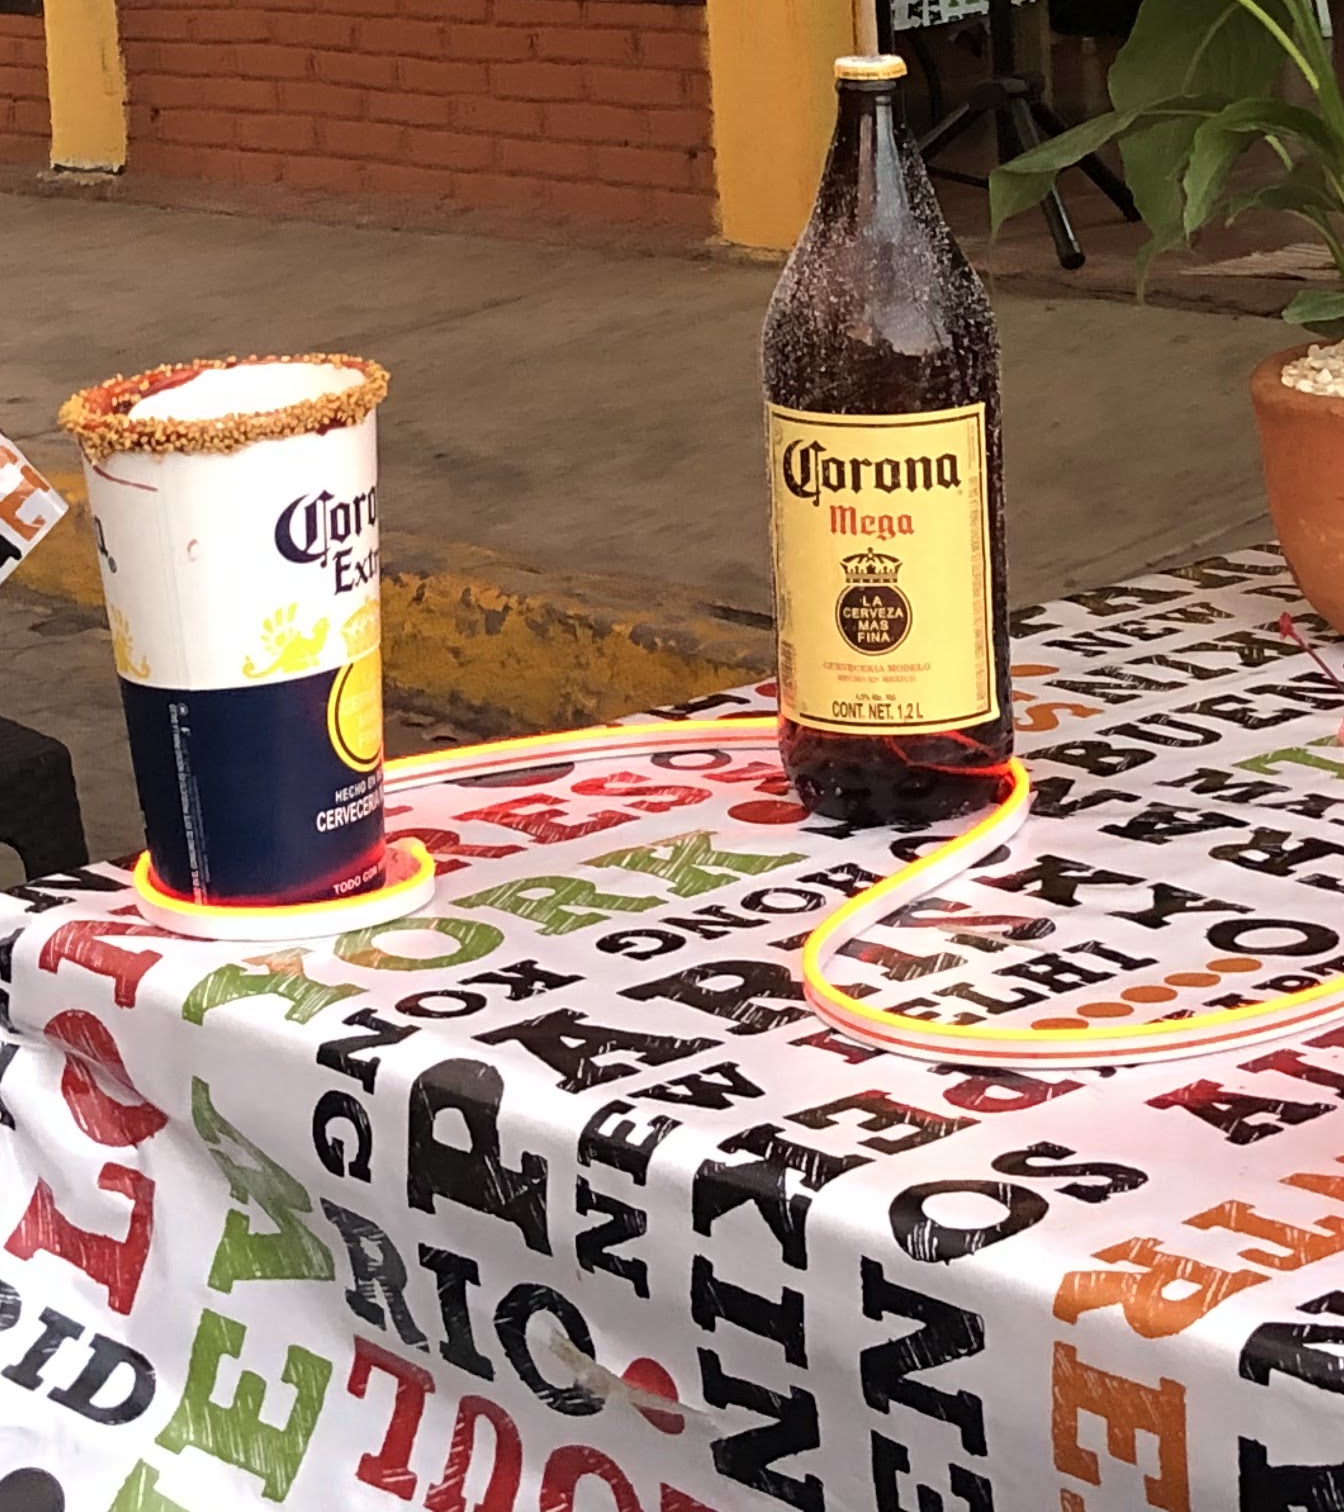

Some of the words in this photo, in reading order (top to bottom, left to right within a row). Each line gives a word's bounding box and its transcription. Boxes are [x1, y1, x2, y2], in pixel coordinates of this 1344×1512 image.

[782, 438, 963, 507] Corona
[829, 505, 916, 541] Mega
[842, 606, 905, 619] CERVEZA
[862, 595, 883, 607] LA
[857, 619, 890, 631] MAS
[857, 631, 892, 643] FINA
[181, 830, 810, 1027] YORK
[596, 860, 885, 961] HONG
[319, 1196, 607, 1418] RIO
